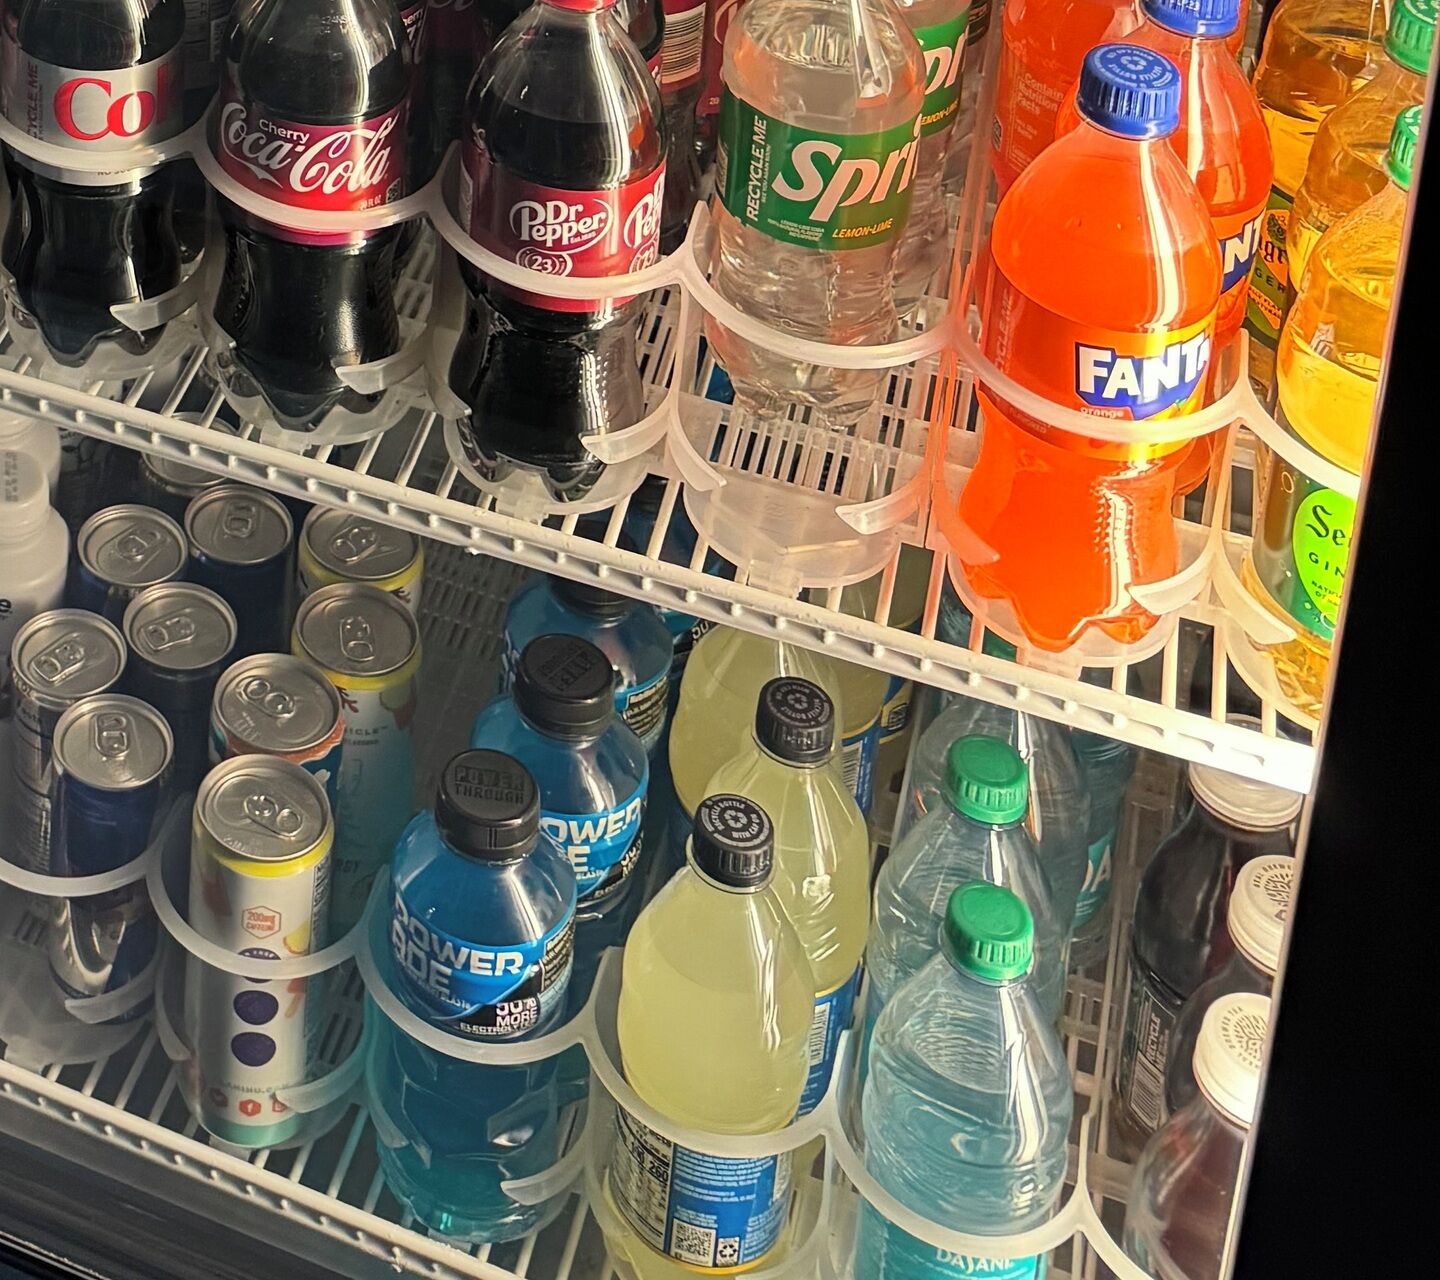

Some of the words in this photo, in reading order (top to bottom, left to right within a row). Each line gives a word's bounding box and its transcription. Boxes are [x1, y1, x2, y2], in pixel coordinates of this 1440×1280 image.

[26, 62, 38, 88] ME
[54, 70, 164, 141] Co
[258, 119, 310, 145] Cherry
[753, 115, 767, 145] ME
[220, 102, 400, 196] Coca-Cola
[771, 114, 923, 222] Spri
[746, 144, 765, 222] RECYCLE
[546, 200, 581, 223] Dr
[520, 207, 605, 249] Pepper
[831, 218, 893, 239] LEMON-LIME
[530, 254, 554, 273] 23
[454, 766, 527, 791] POWER
[454, 783, 525, 806] THROUGH
[393, 889, 525, 977] POWER
[494, 1009, 540, 1030] MORE
[648, 1159, 669, 1183] 260
